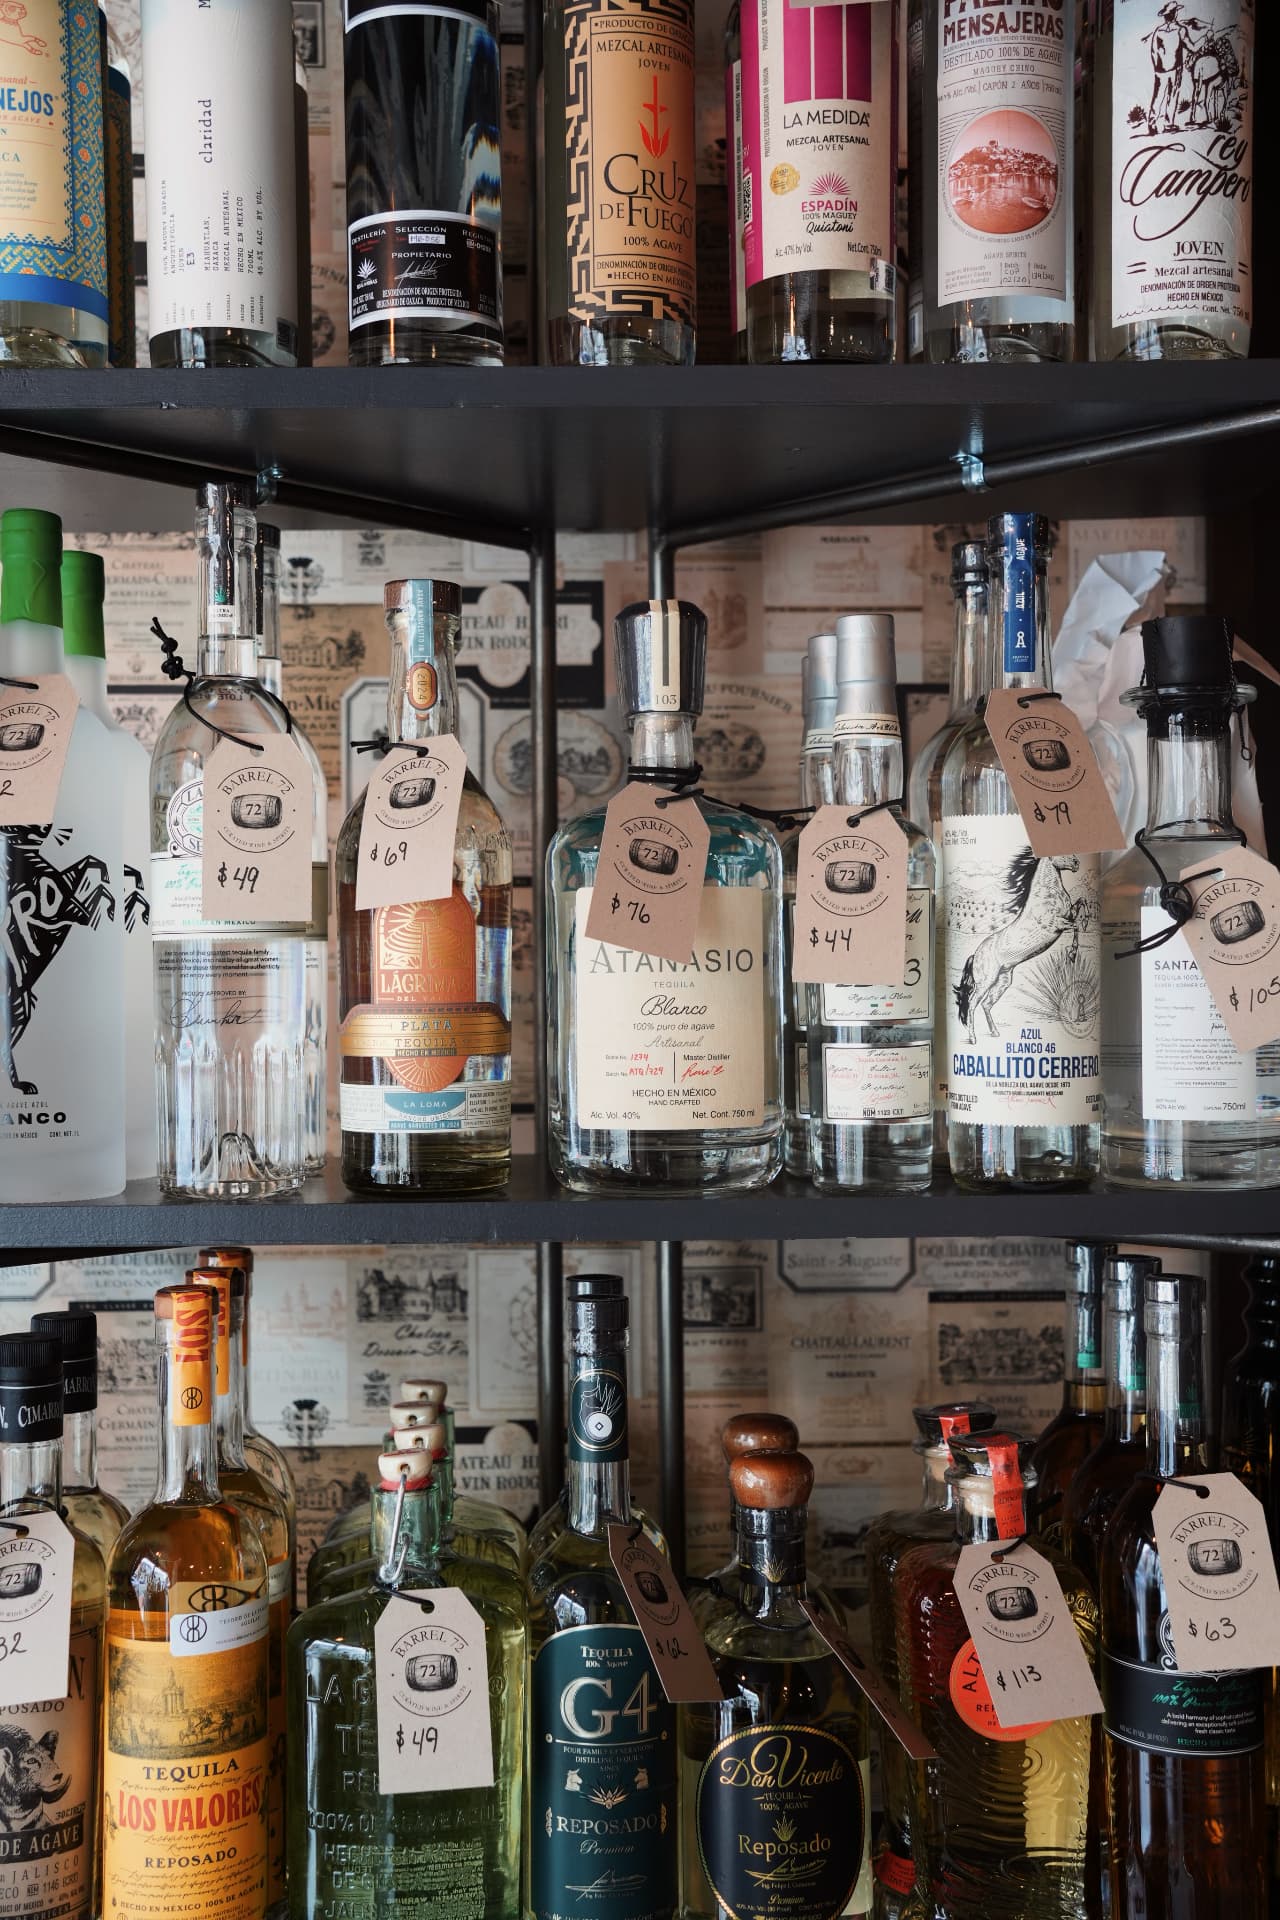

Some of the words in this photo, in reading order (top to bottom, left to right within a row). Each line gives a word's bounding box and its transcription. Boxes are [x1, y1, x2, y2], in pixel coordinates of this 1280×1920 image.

[600, 19, 654, 30] PRODUCTO
[944, 10, 1064, 46] MENSAJERAS
[596, 39, 644, 53] MEZCAL
[944, 48, 994, 69] DESTILADO
[999, 47, 1020, 57] 100%
[1024, 46, 1035, 57] DE
[638, 58, 671, 72] JOVEN
[784, 114, 802, 129] LA
[198, 99, 213, 164] claridad
[786, 135, 821, 147] MEZCAL
[822, 135, 870, 146] ARTESANAL
[801, 198, 858, 213] ESPADÍN
[822, 212, 857, 220] MAGUEY
[351, 229, 386, 245] DESTILERÍA
[623, 236, 650, 247] 100%
[652, 238, 683, 253] AGAVE
[1173, 241, 1224, 256] JOVEN
[614, 272, 650, 280] HECHO
[652, 274, 663, 282] EN
[1154, 265, 1190, 277] Mezcal
[1192, 266, 1233, 278] artesanal
[1141, 279, 1186, 293] DENOMINACIÓN
[1167, 293, 1189, 301] HECHO
[1015, 538, 1025, 561] AGAVE
[1015, 592, 1025, 610] AZUL
[416, 672, 428, 701] 2024
[46, 711, 56, 724] 72
[9, 731, 24, 741] 72
[1010, 720, 1051, 744] BARREL
[1055, 727, 1068, 739] 72
[1036, 748, 1052, 760] 72
[384, 760, 432, 784] BARREL
[433, 763, 446, 776] 72
[221, 771, 274, 796] BARREL
[276, 779, 292, 795] 72
[402, 786, 417, 797] 72
[245, 803, 262, 816] 72
[623, 819, 674, 838] BARREL
[674, 836, 690, 850] 72
[643, 847, 659, 861] 72
[816, 839, 868, 862] BARREL
[872, 848, 885, 862] 72
[839, 870, 855, 880] 72
[1195, 883, 1240, 919] BARREL
[1246, 883, 1260, 896] 72
[1224, 916, 1243, 930] 72
[1154, 960, 1198, 971] SANTA
[640, 995, 708, 1016] Blanco
[401, 1020, 452, 1031] PLATA
[633, 1023, 655, 1031] 100%
[656, 1024, 676, 1032] puro
[691, 1023, 716, 1032] agave
[1020, 1027, 1042, 1040] AZUL
[395, 1038, 457, 1047] TEQUILA
[1006, 1042, 1043, 1054] BLANCO
[1045, 1042, 1056, 1053] 46
[707, 1053, 731, 1061] Distiller
[953, 1054, 1035, 1078] CABALLITO
[1039, 1055, 1099, 1078] CERRERO
[632, 1089, 665, 1098] HECHO
[667, 1089, 680, 1097] EN
[682, 1088, 717, 1097] MÉXICO
[590, 1111, 604, 1120] Alc.
[606, 1111, 621, 1120] Vol.
[622, 1111, 641, 1120] 40%
[692, 1111, 709, 1120] Net.
[710, 1110, 731, 1119] Cont.
[732, 1110, 745, 1118] 750
[1174, 1515, 1227, 1544] BARREL
[1231, 1522, 1246, 1538] 72
[38, 1546, 52, 1561] 72
[1202, 1549, 1219, 1563] 72
[5, 1573, 21, 1585] 72
[973, 1566, 1018, 1593] BARREL
[1023, 1571, 1037, 1585] 72
[1000, 1597, 1018, 1609] 72
[395, 1630, 447, 1659] BARREL
[449, 1637, 465, 1654] 72
[580, 1645, 633, 1660] TEQUILA
[420, 1665, 437, 1677] 72
[560, 1671, 658, 1739] G4
[719, 1756, 776, 1788] Don
[750, 1734, 844, 1789] Vicente
[143, 1758, 239, 1782] TEQUILA
[118, 1790, 157, 1832] LOS
[162, 1774, 262, 1833] VALORES
[759, 1803, 780, 1811] 100%
[556, 1815, 658, 1835] REPOSADO
[29, 1824, 79, 1854] AGAVE
[737, 1832, 831, 1862] Reposado
[144, 1847, 237, 1868] REPOSADO
[11, 1855, 79, 1881] JALISCO
[120, 1901, 146, 1911] HECHO
[150, 1904, 160, 1912] EN
[205, 1899, 223, 1908] 100%
